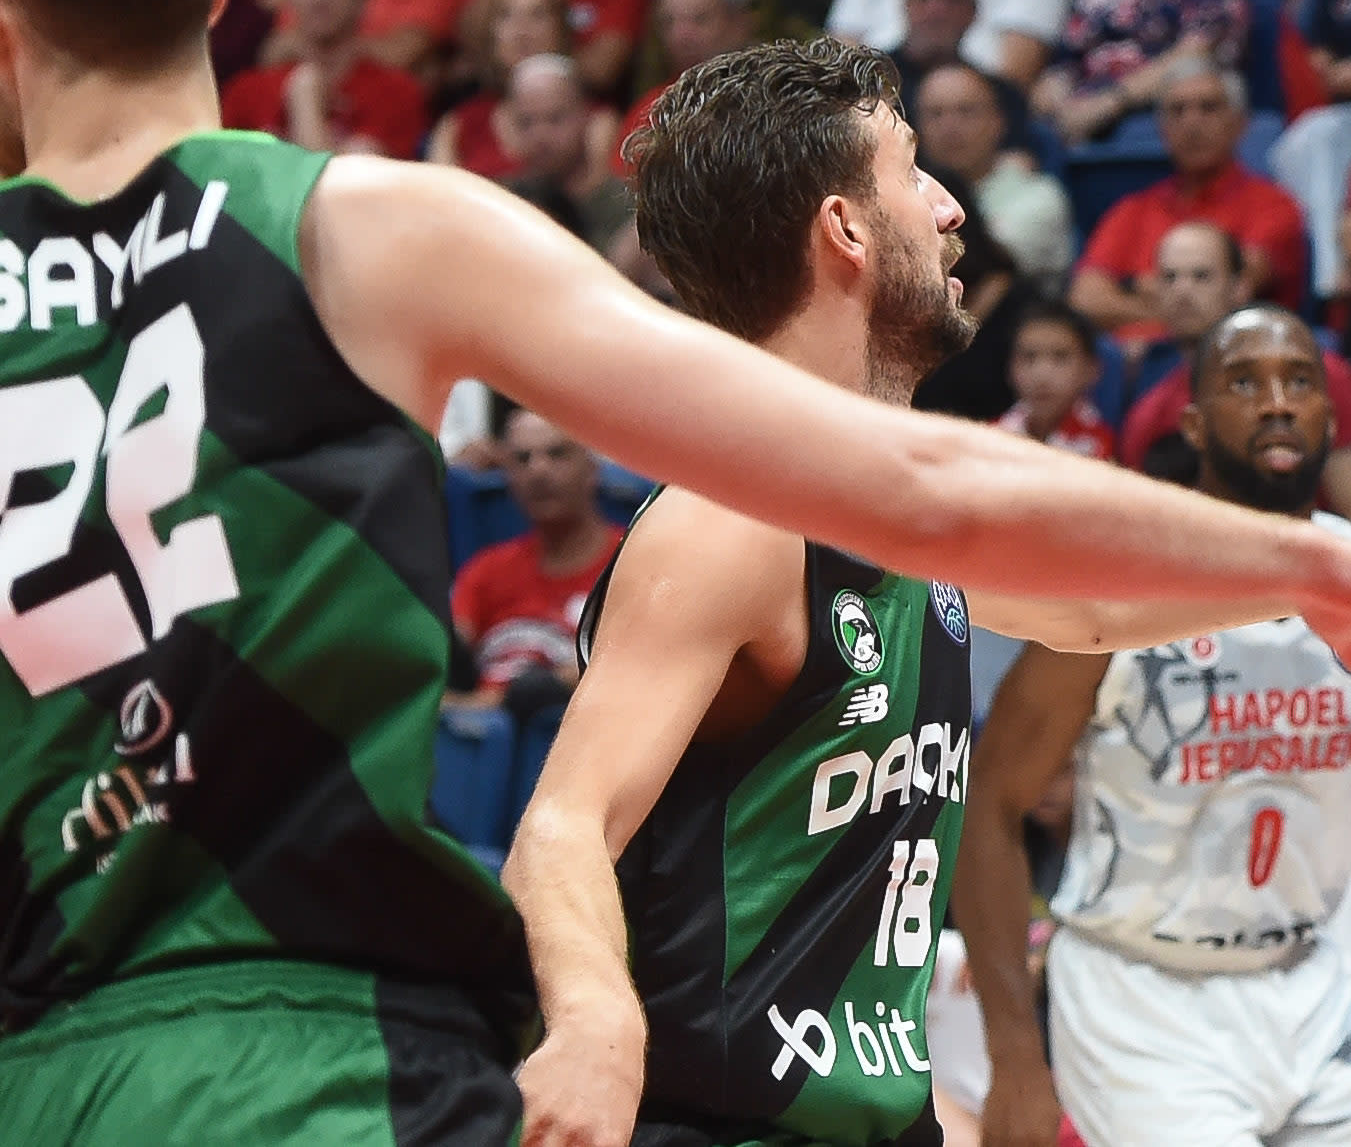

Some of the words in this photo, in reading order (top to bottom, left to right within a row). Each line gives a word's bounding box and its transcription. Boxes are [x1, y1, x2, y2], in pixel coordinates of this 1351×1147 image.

[1208, 686, 1350, 735] HAPOEL
[1249, 805, 1286, 890] 0
[873, 837, 940, 968] 18
